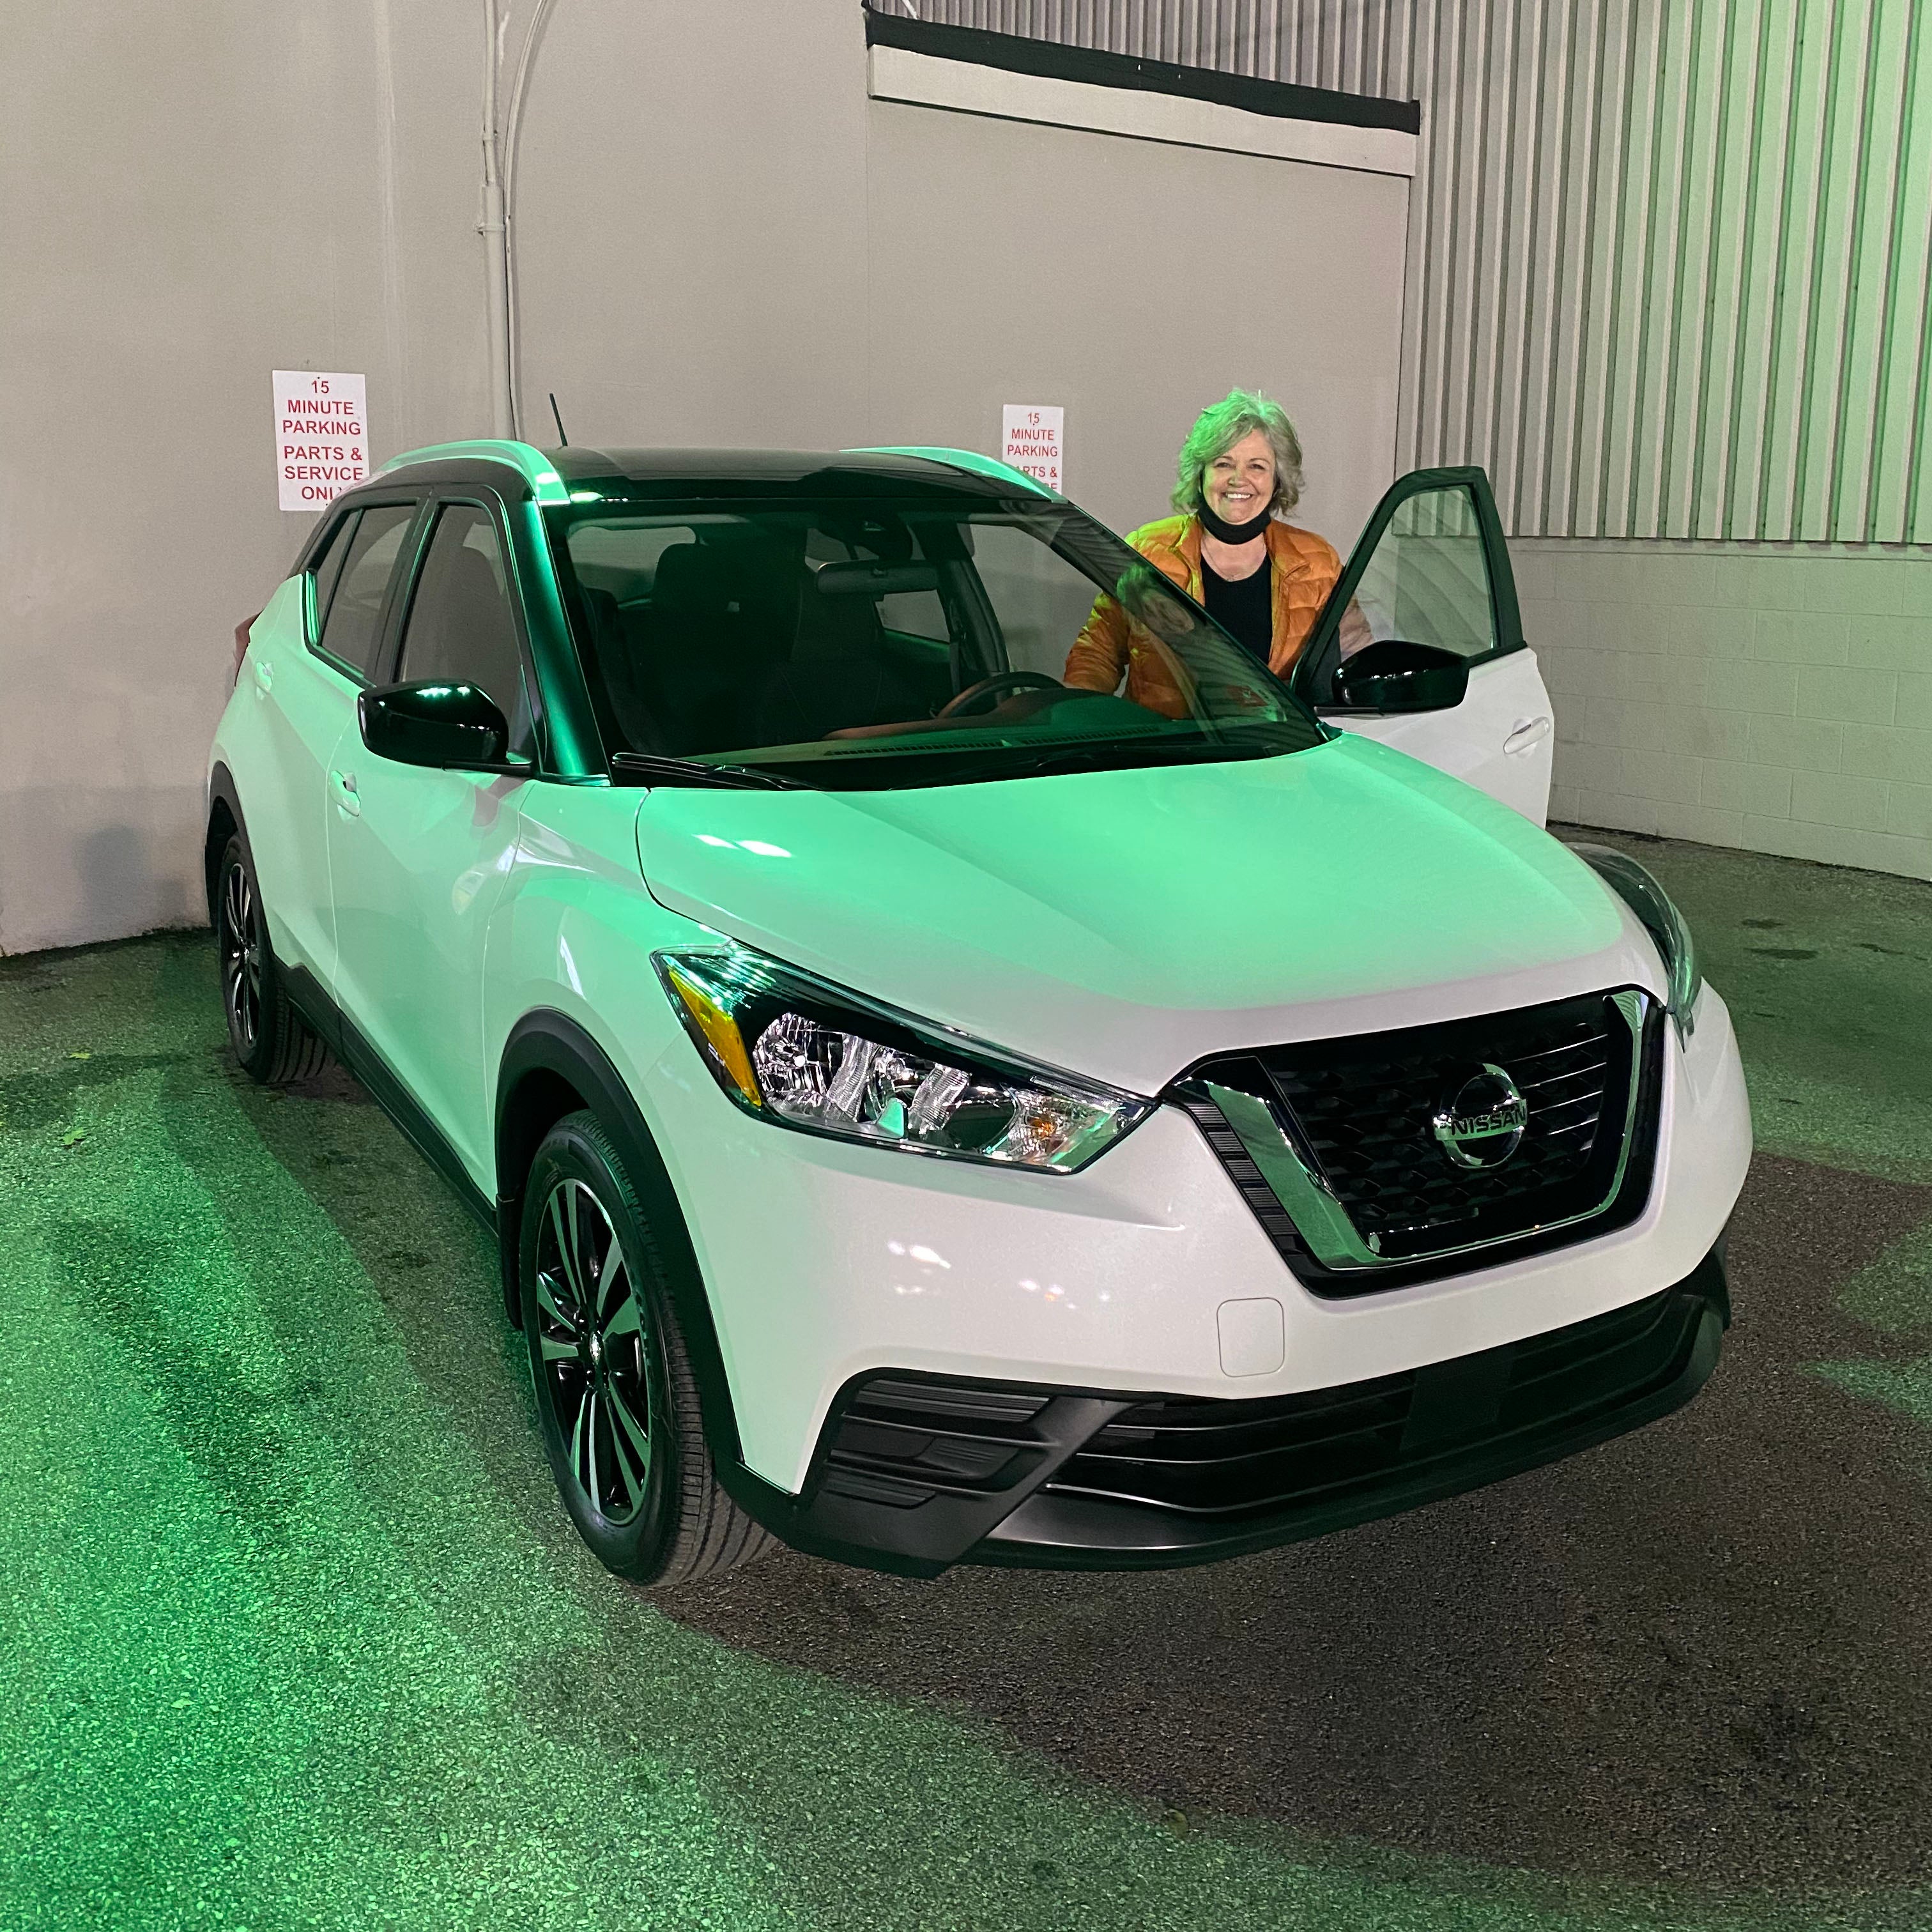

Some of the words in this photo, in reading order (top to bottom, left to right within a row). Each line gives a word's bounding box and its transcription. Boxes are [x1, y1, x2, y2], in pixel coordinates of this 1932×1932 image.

[312, 381, 330, 394] 15
[288, 400, 354, 415] MINUTE
[1028, 412, 1040, 424] 15
[282, 420, 361, 435] PARKING
[1011, 428, 1054, 440] MINUTE
[284, 446, 344, 460] PARTS
[351, 447, 362, 461] &
[1007, 445, 1058, 457] PARKING
[284, 466, 364, 480] SERVICE
[1050, 466, 1057, 477] &
[302, 486, 342, 500] ONL
[1451, 1103, 1526, 1135] NISSAN
